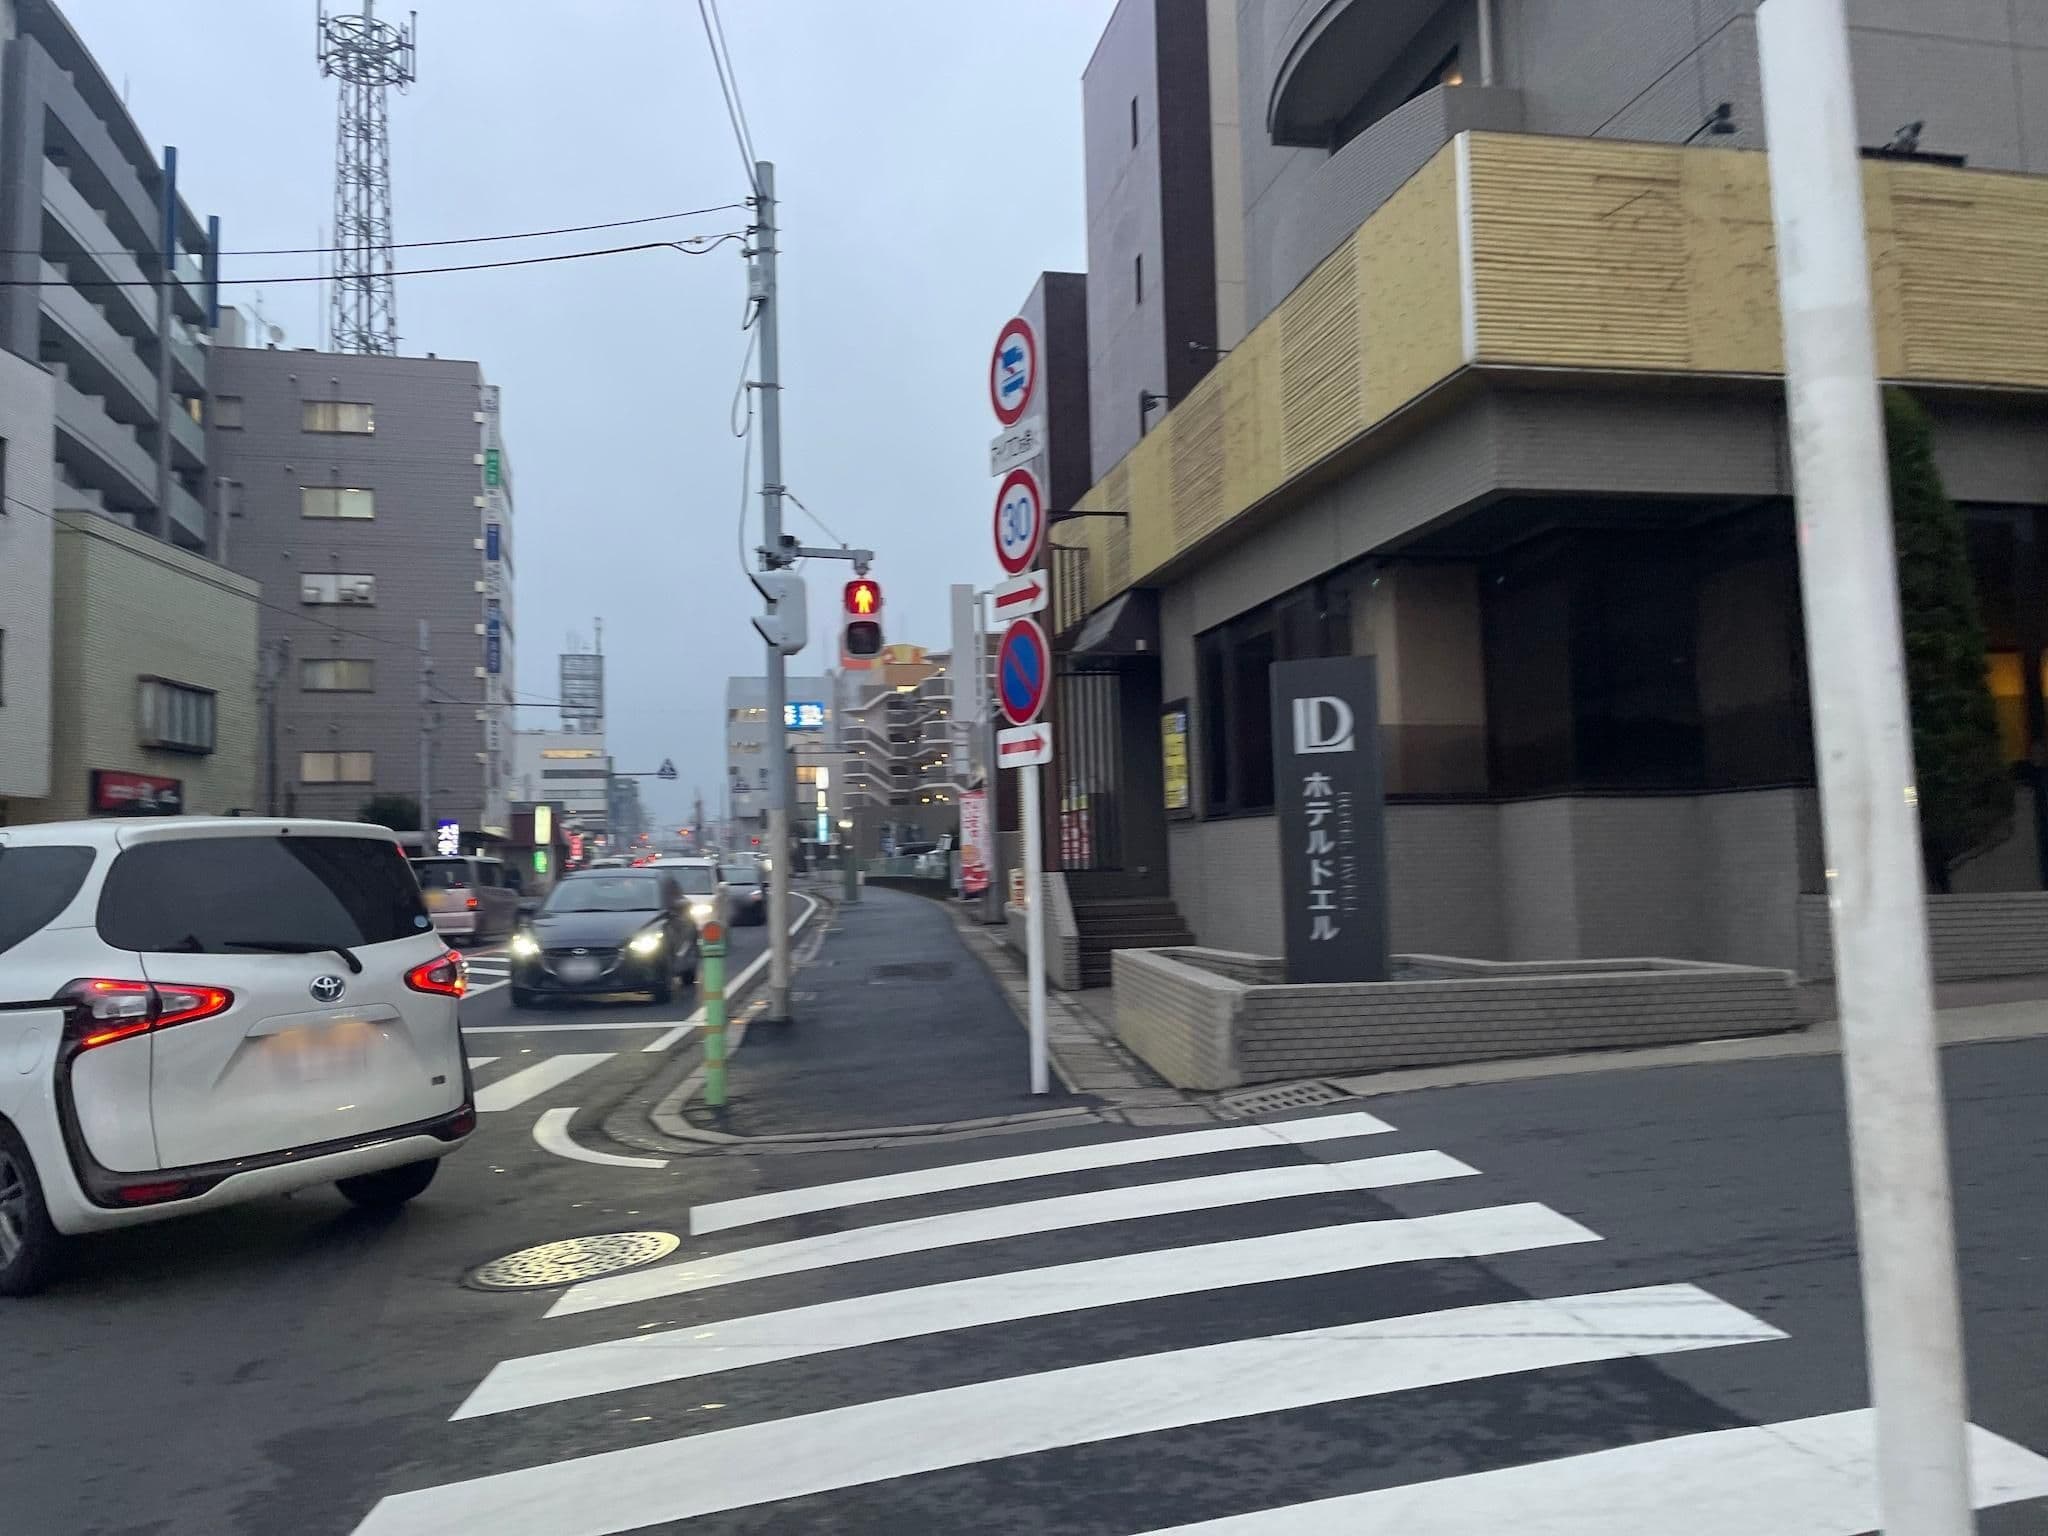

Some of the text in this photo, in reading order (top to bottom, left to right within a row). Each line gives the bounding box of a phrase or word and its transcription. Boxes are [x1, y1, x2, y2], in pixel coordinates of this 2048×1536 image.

[1003, 497, 1032, 546] 30
[1303, 772, 1341, 941] ホテルドエル
